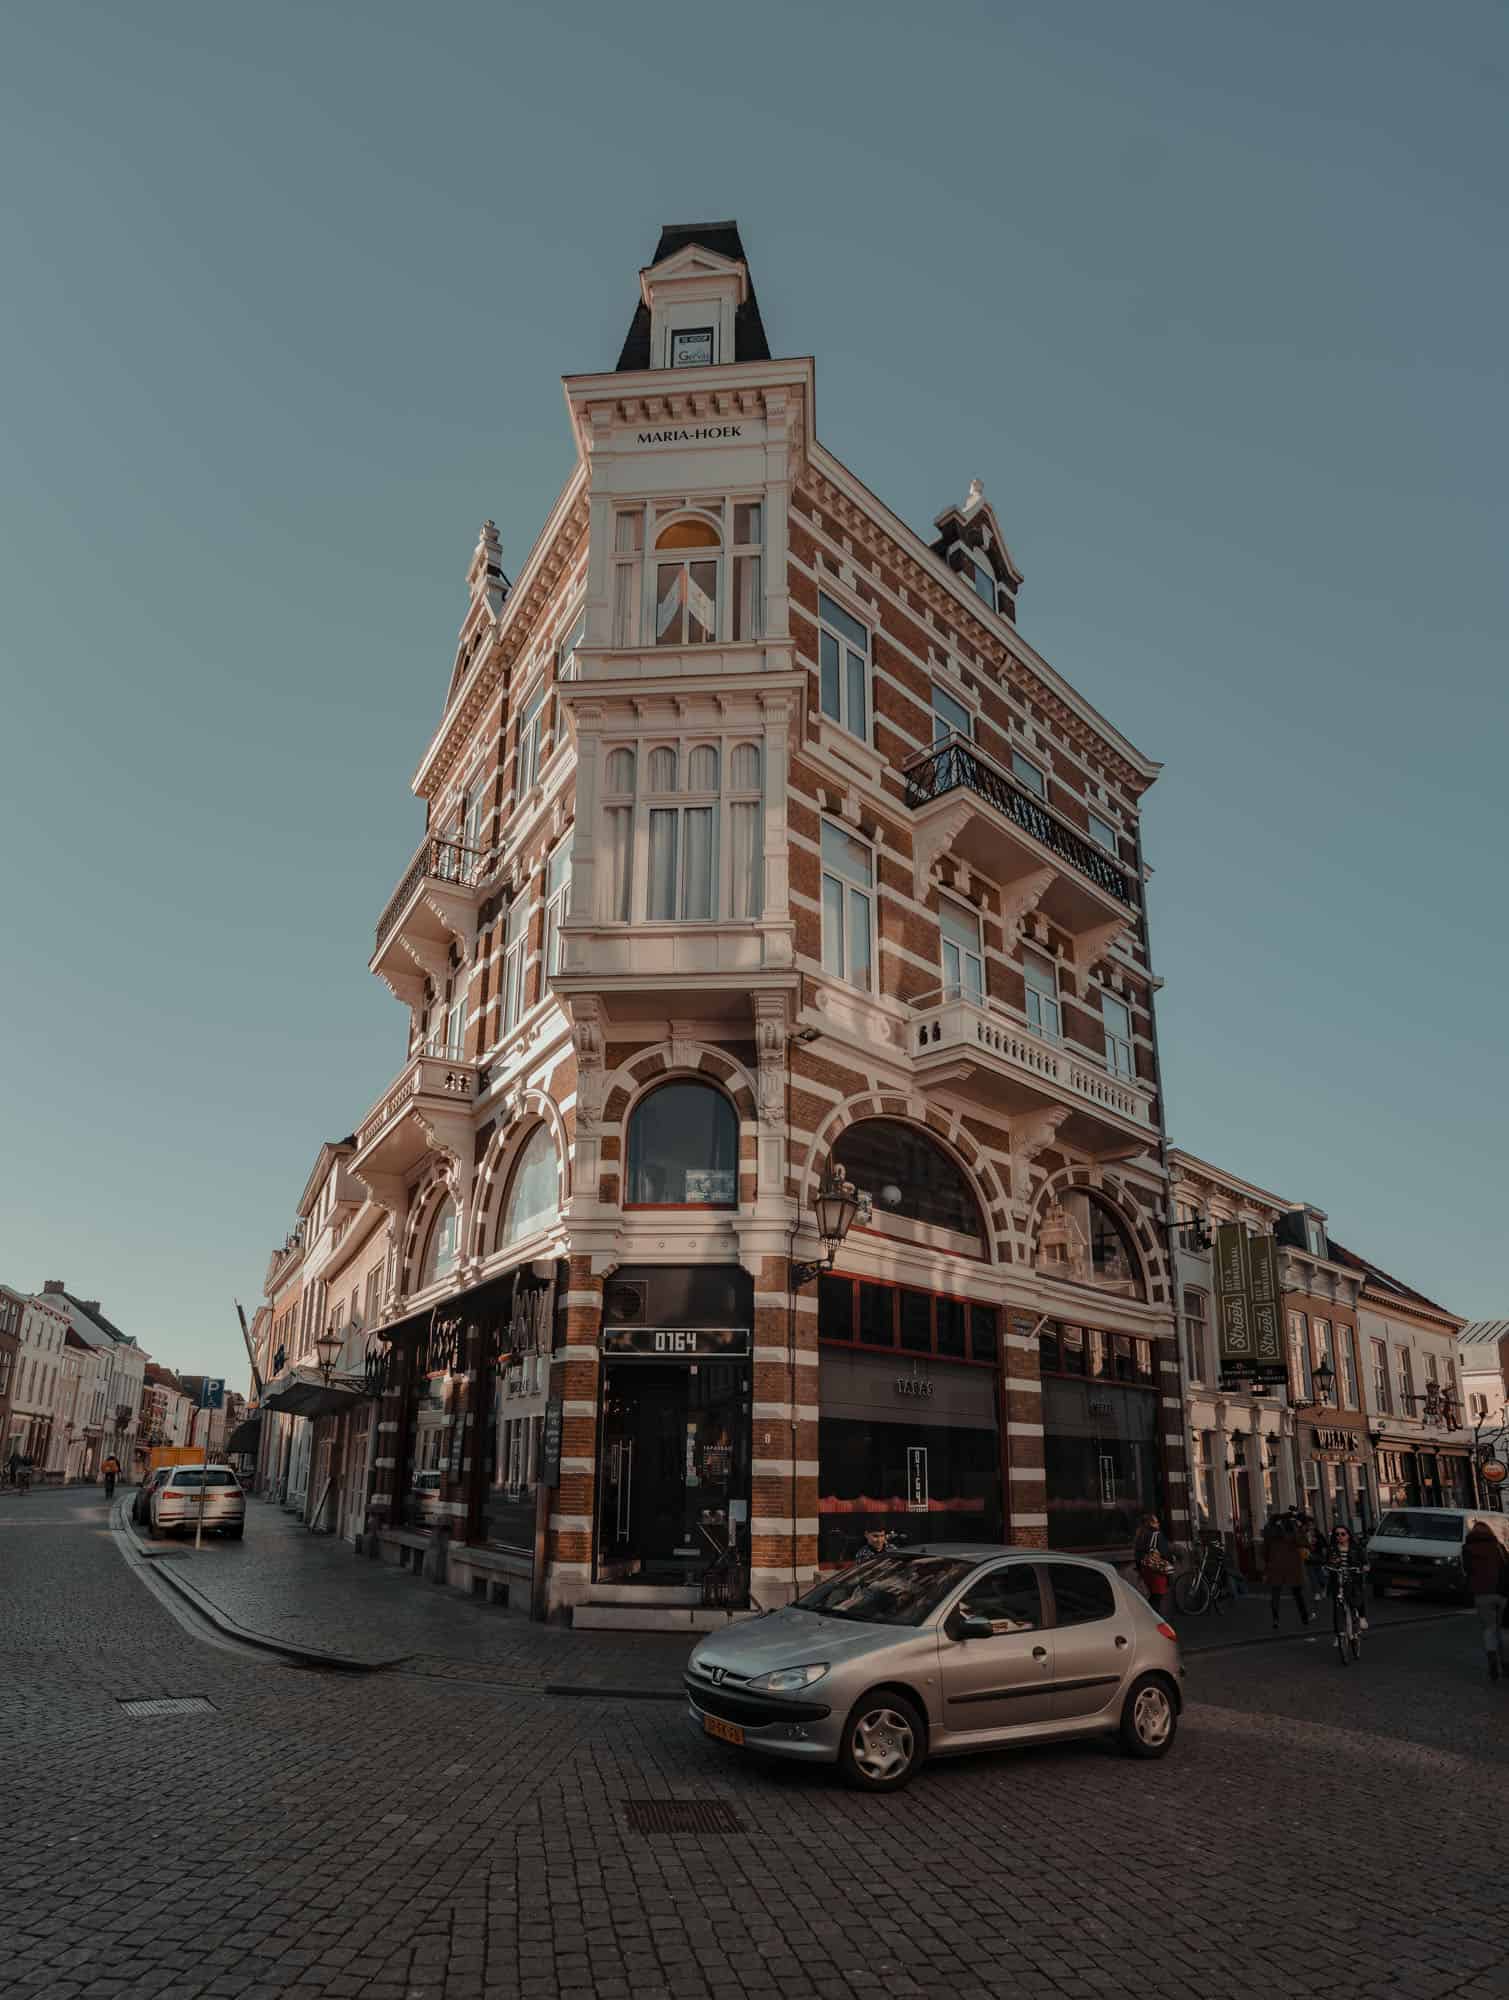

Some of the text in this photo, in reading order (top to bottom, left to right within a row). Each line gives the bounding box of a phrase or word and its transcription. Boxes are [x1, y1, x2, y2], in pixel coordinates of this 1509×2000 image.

[637, 426, 742, 444] MARIA-HOEK
[655, 1332, 697, 1352] 0164
[208, 1381, 221, 1397] P
[1316, 1428, 1360, 1450] WILLY'S
